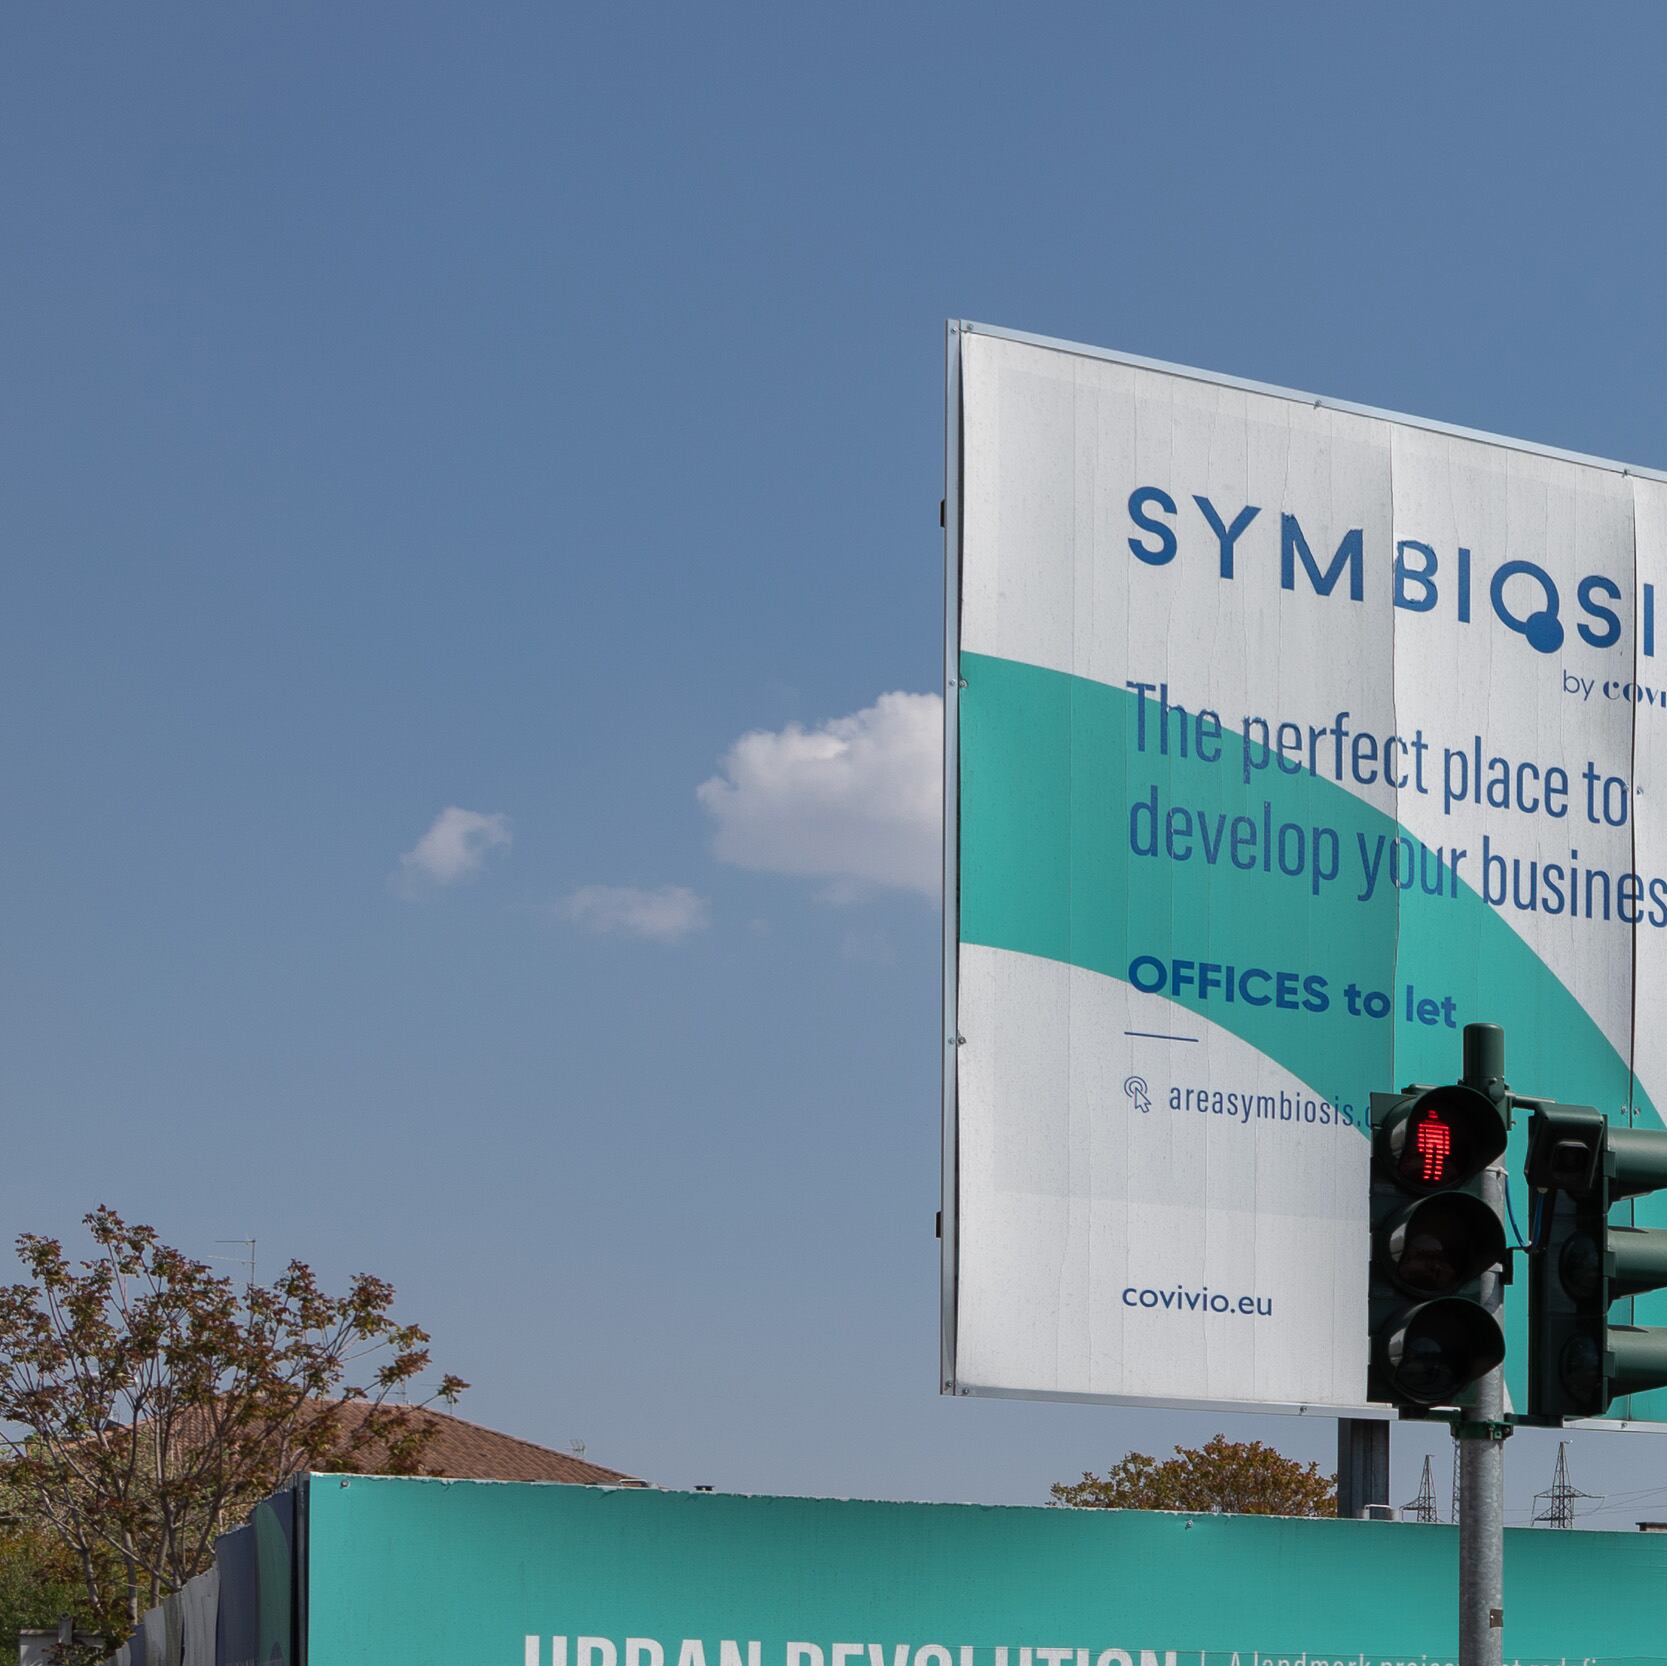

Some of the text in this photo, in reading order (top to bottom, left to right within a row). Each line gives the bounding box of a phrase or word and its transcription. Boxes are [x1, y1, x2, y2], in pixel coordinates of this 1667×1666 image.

[1562, 669, 1595, 701] by
[1126, 681, 1628, 827] The perfect place to
[1129, 784, 1340, 897] develop
[1356, 831, 1468, 902] your
[1128, 955, 1457, 1029] OFFICES to let
[1122, 1284, 1273, 1316] covivio.eu
